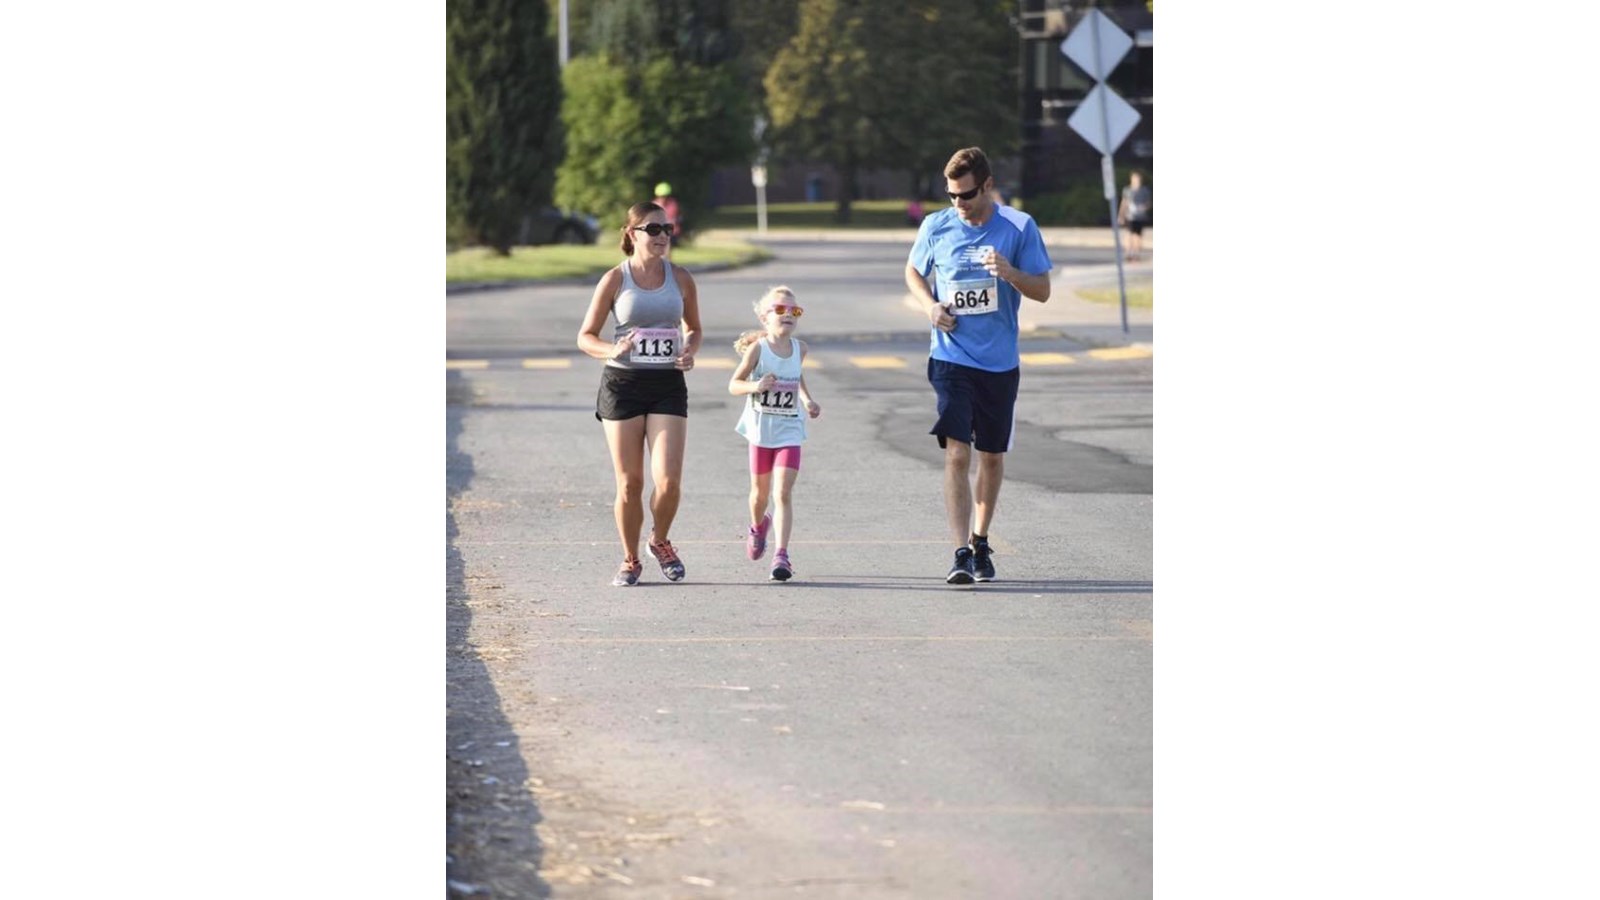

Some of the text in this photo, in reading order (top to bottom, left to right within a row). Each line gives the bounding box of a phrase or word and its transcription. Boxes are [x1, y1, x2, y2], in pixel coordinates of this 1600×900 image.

[955, 289, 990, 309] 664
[638, 339, 673, 357] 113
[760, 390, 793, 408] 112
